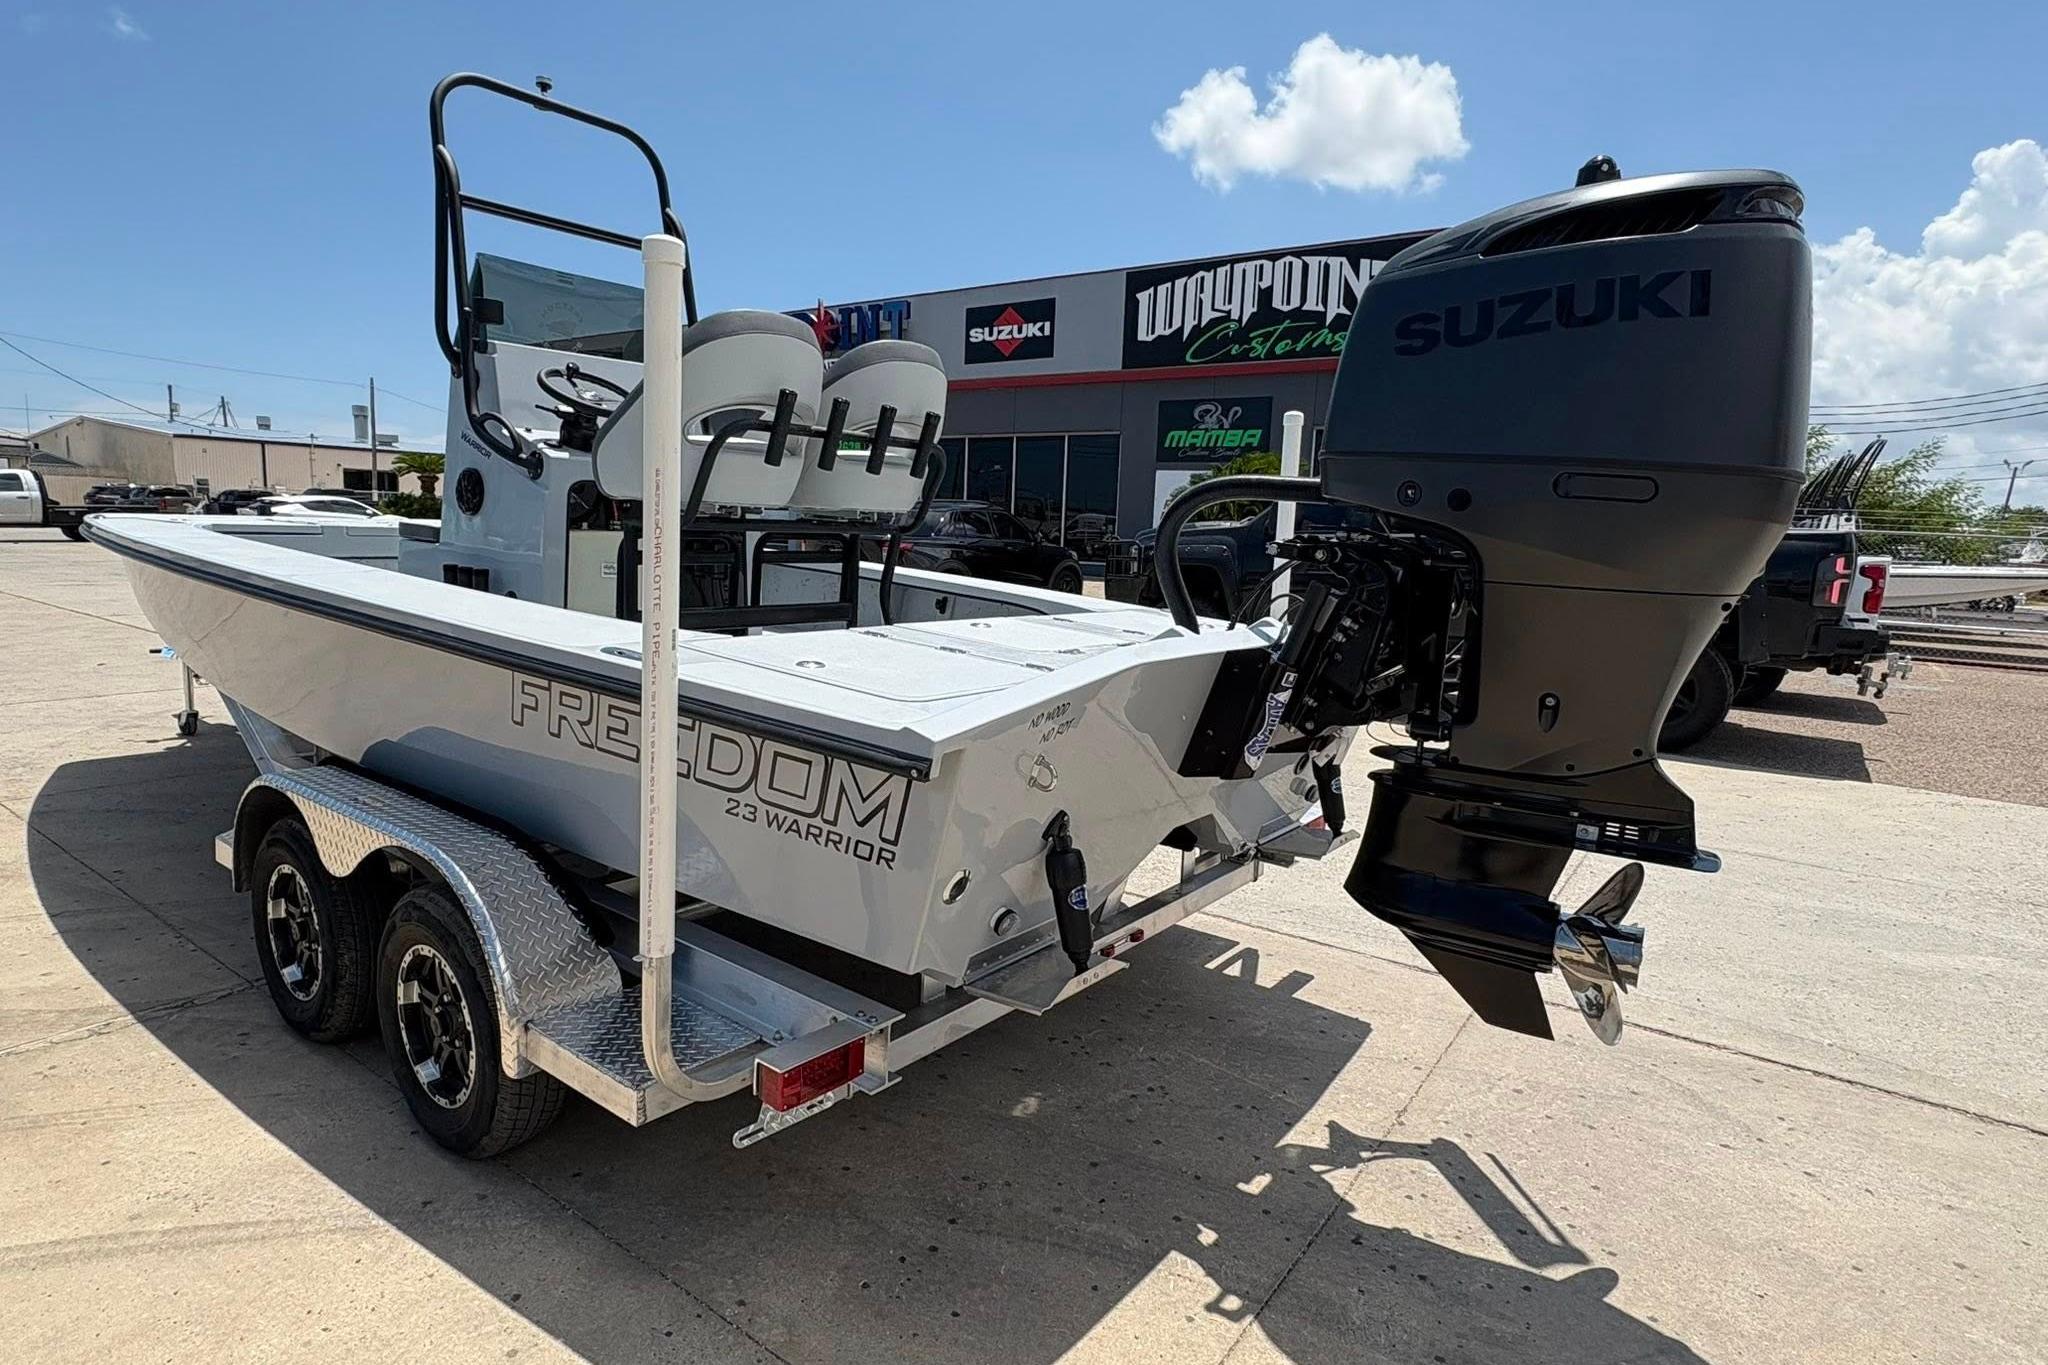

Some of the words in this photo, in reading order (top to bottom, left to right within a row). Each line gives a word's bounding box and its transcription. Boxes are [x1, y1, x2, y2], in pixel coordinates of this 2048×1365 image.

[1394, 269, 1712, 357] SUZUKI
[969, 321, 1051, 343] SUZUKI
[1185, 320, 1348, 363] Customs
[461, 431, 492, 460] WARRIOR
[1164, 429, 1262, 448] MAMBA
[653, 527, 663, 612] CHARLOTTE
[652, 622, 661, 659] PIPE
[1028, 712, 1045, 731] NO
[1039, 726, 1055, 745] NO
[725, 797, 758, 823] 23
[765, 809, 897, 871] WARRIOR
